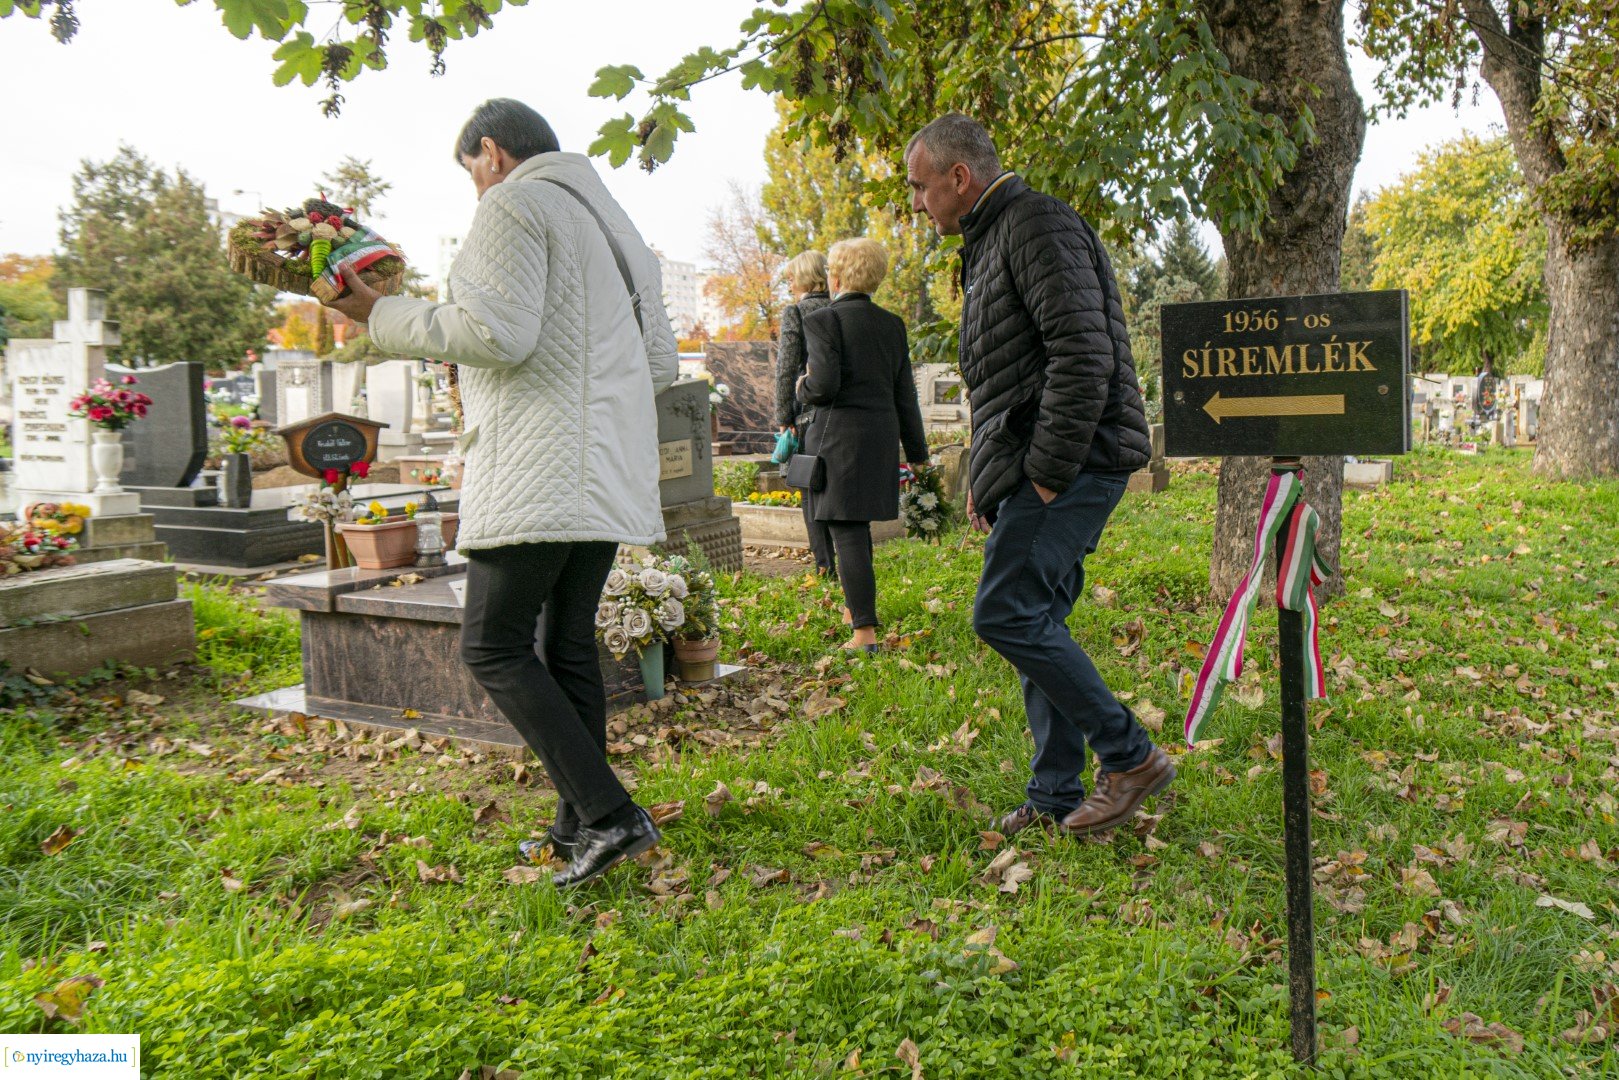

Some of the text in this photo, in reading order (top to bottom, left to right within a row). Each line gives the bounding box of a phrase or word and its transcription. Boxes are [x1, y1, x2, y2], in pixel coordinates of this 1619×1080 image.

[1222, 309, 1279, 333] 1956
[1303, 313, 1332, 329] os
[1181, 335, 1378, 379] SÍREMLÉK
